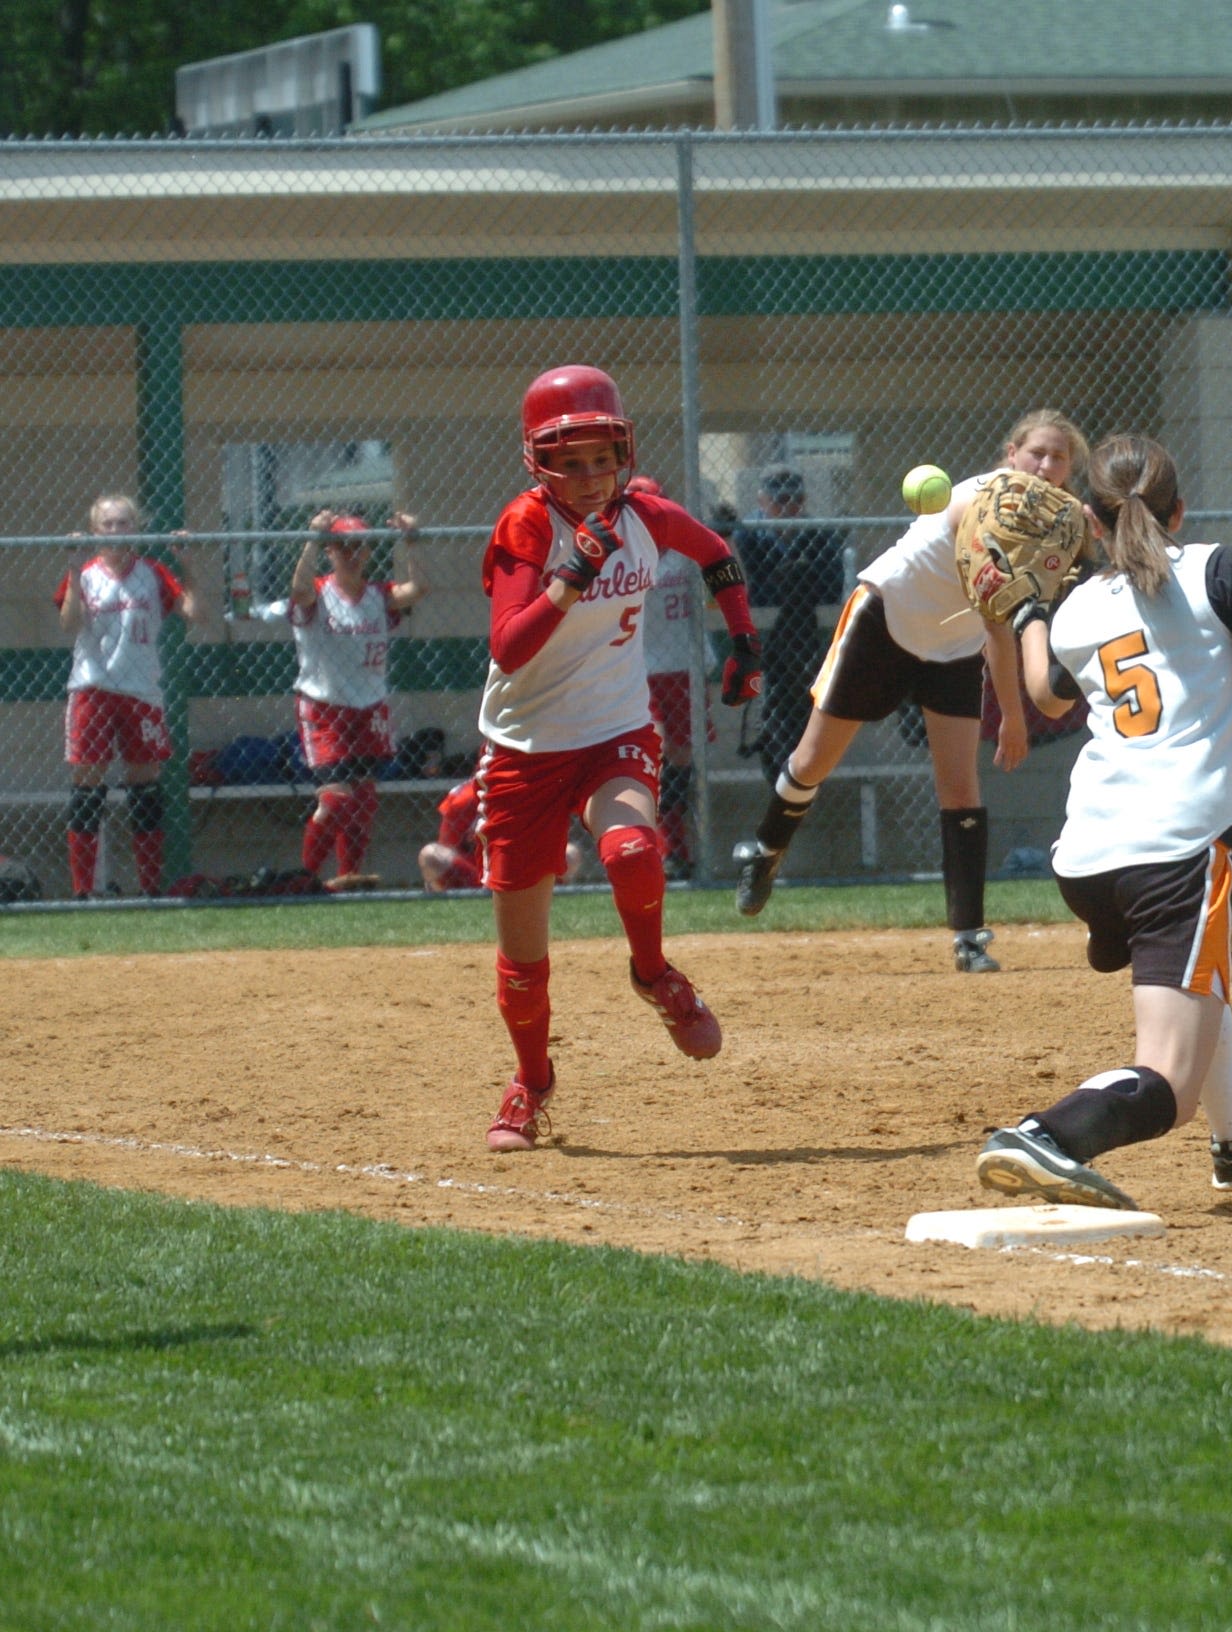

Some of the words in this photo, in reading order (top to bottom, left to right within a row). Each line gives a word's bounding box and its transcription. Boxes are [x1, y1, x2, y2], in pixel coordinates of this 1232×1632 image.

[609, 604, 643, 647] 5
[364, 641, 388, 667] 12
[1098, 628, 1163, 739] 5
